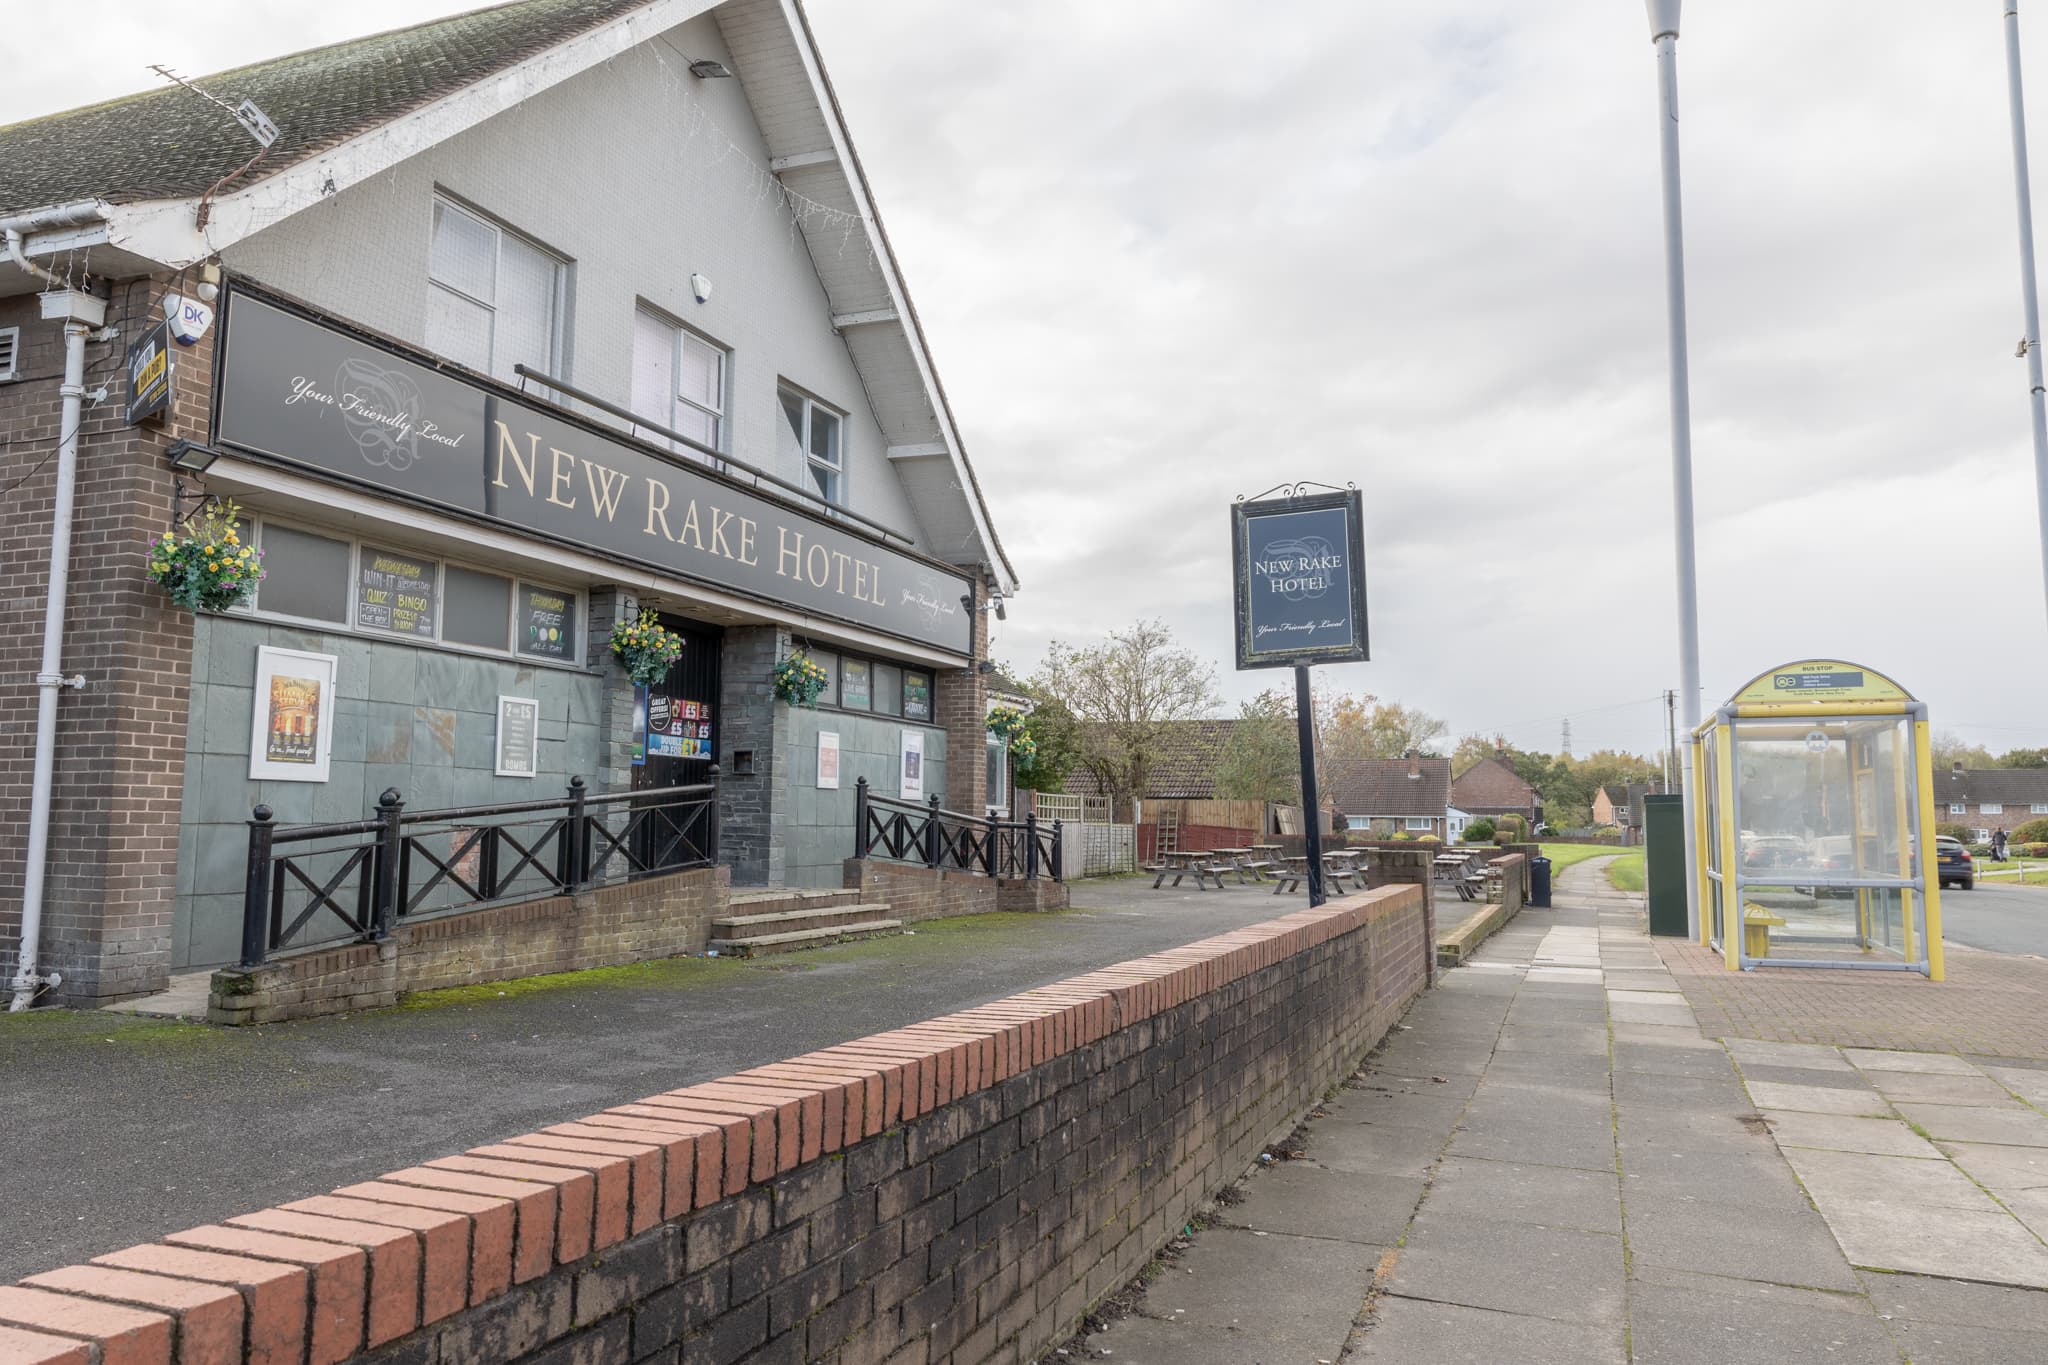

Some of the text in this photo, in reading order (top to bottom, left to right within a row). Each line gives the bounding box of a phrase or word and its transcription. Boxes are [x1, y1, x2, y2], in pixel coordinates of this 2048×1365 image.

[184, 305, 204, 325] DK
[285, 376, 465, 448] Your Friendly Local
[492, 420, 887, 607] NEW RAKE HOTEL
[1255, 555, 1342, 575] NEW RAKE
[1271, 576, 1327, 593] HOTEL
[398, 594, 427, 612] BINGO
[901, 588, 956, 616] Your Friendly Local
[1256, 618, 1346, 638] Your Friendly Local
[686, 704, 697, 718] £5
[671, 722, 682, 735] £5
[698, 725, 708, 738] £5
